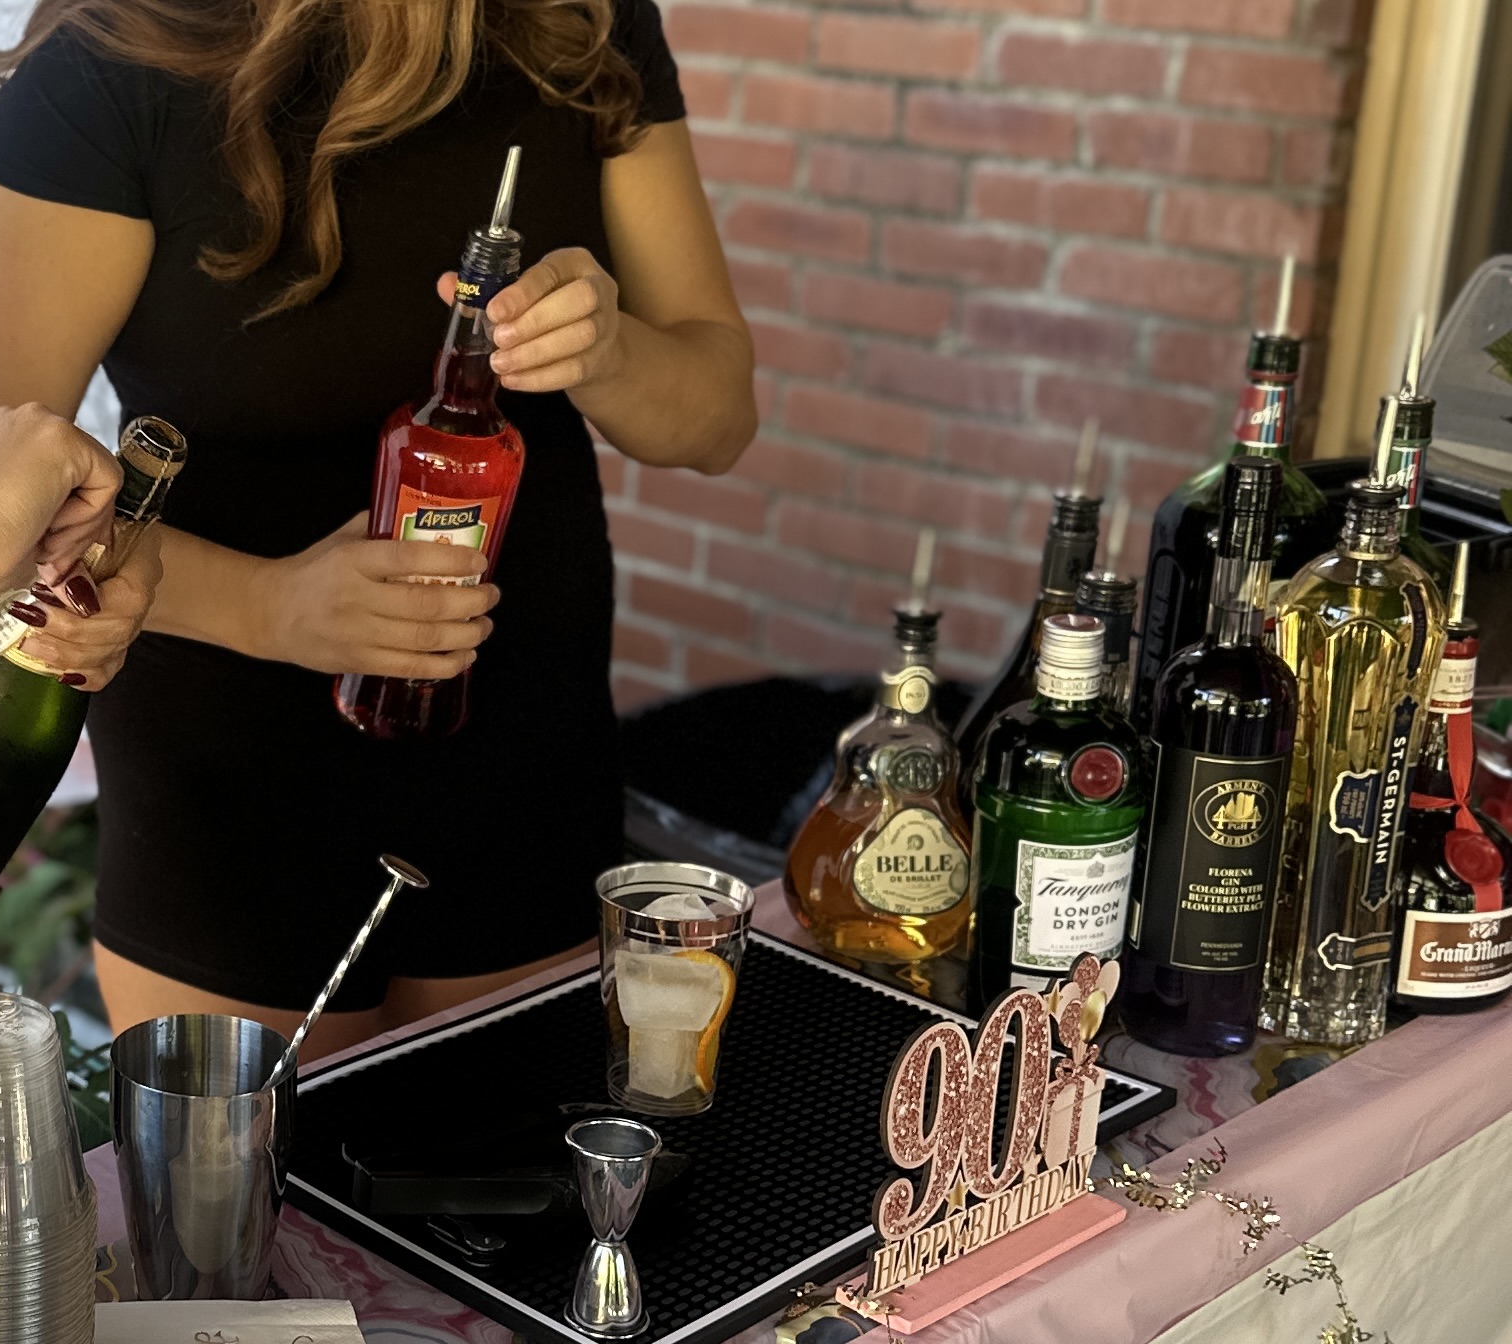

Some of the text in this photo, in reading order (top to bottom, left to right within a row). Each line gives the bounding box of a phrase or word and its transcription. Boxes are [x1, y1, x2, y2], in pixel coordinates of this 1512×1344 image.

[419, 510, 475, 527] APEROL
[1373, 735, 1407, 865] ST-GERMAIN
[877, 855, 953, 873] BELLE
[1209, 867, 1253, 876] FLORENA
[1188, 883, 1264, 895] COLORED WITH
[1221, 878, 1241, 886] GIN
[1181, 900, 1224, 913] FLOWER
[1188, 892, 1246, 904] BUTTERFLY
[1054, 898, 1120, 917] LONDON
[1053, 913, 1119, 930] DRY GIN
[880, 987, 1052, 1241] 90
[873, 1150, 1096, 1295] HAPPY BIRTHDAY
